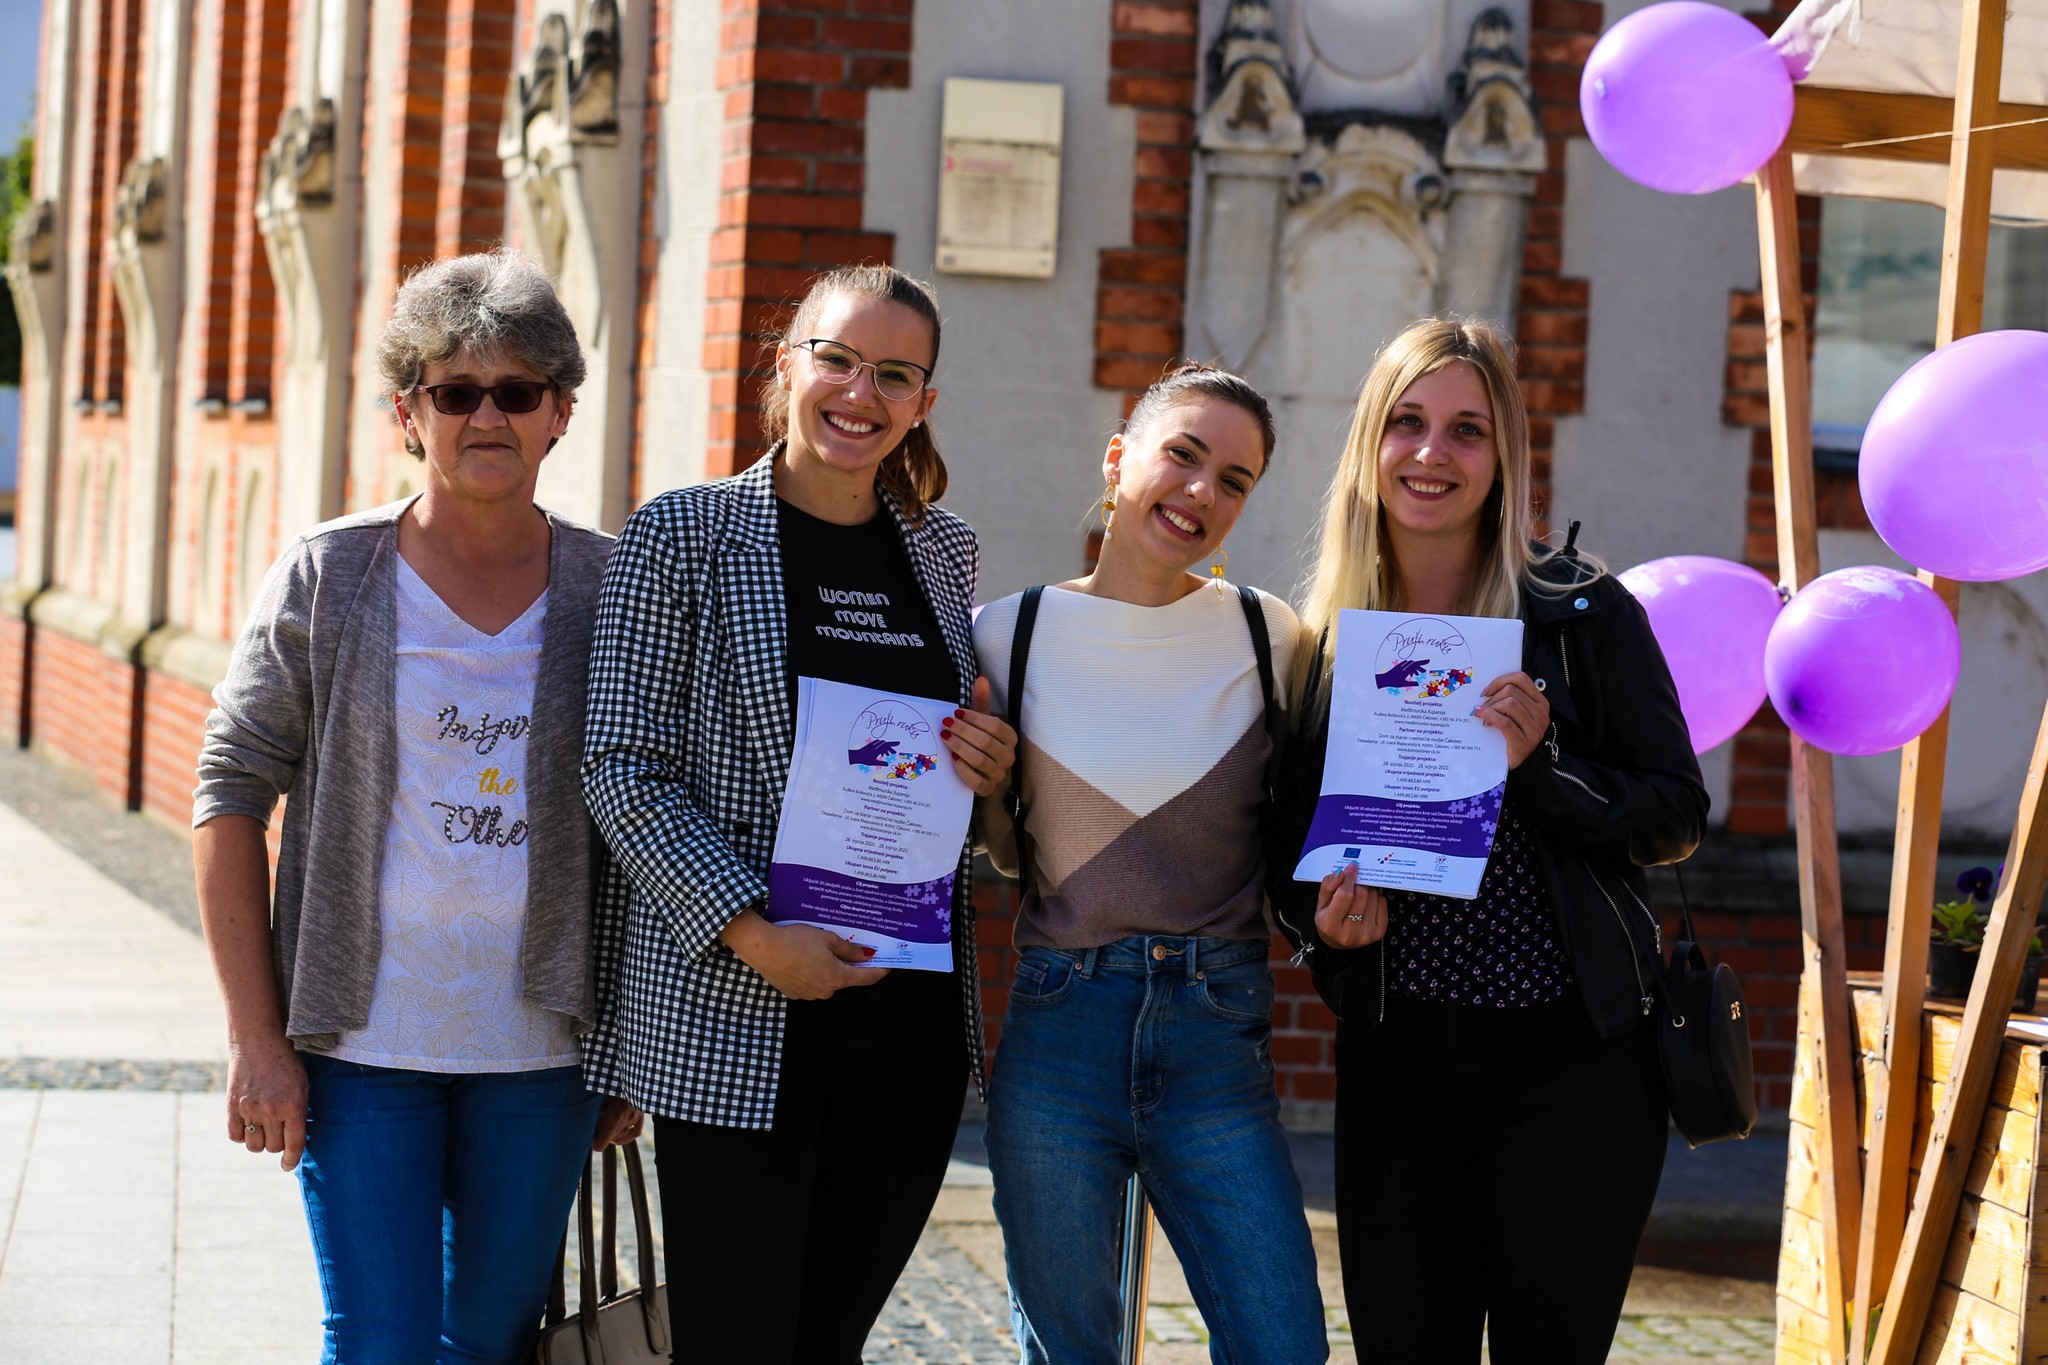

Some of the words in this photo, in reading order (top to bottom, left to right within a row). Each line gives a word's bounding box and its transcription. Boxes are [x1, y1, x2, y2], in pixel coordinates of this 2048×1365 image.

[818, 585, 890, 606] WOMEN
[834, 610, 888, 628] MOVE
[815, 625, 925, 648] MOUNTAINS
[477, 768, 519, 796] the
